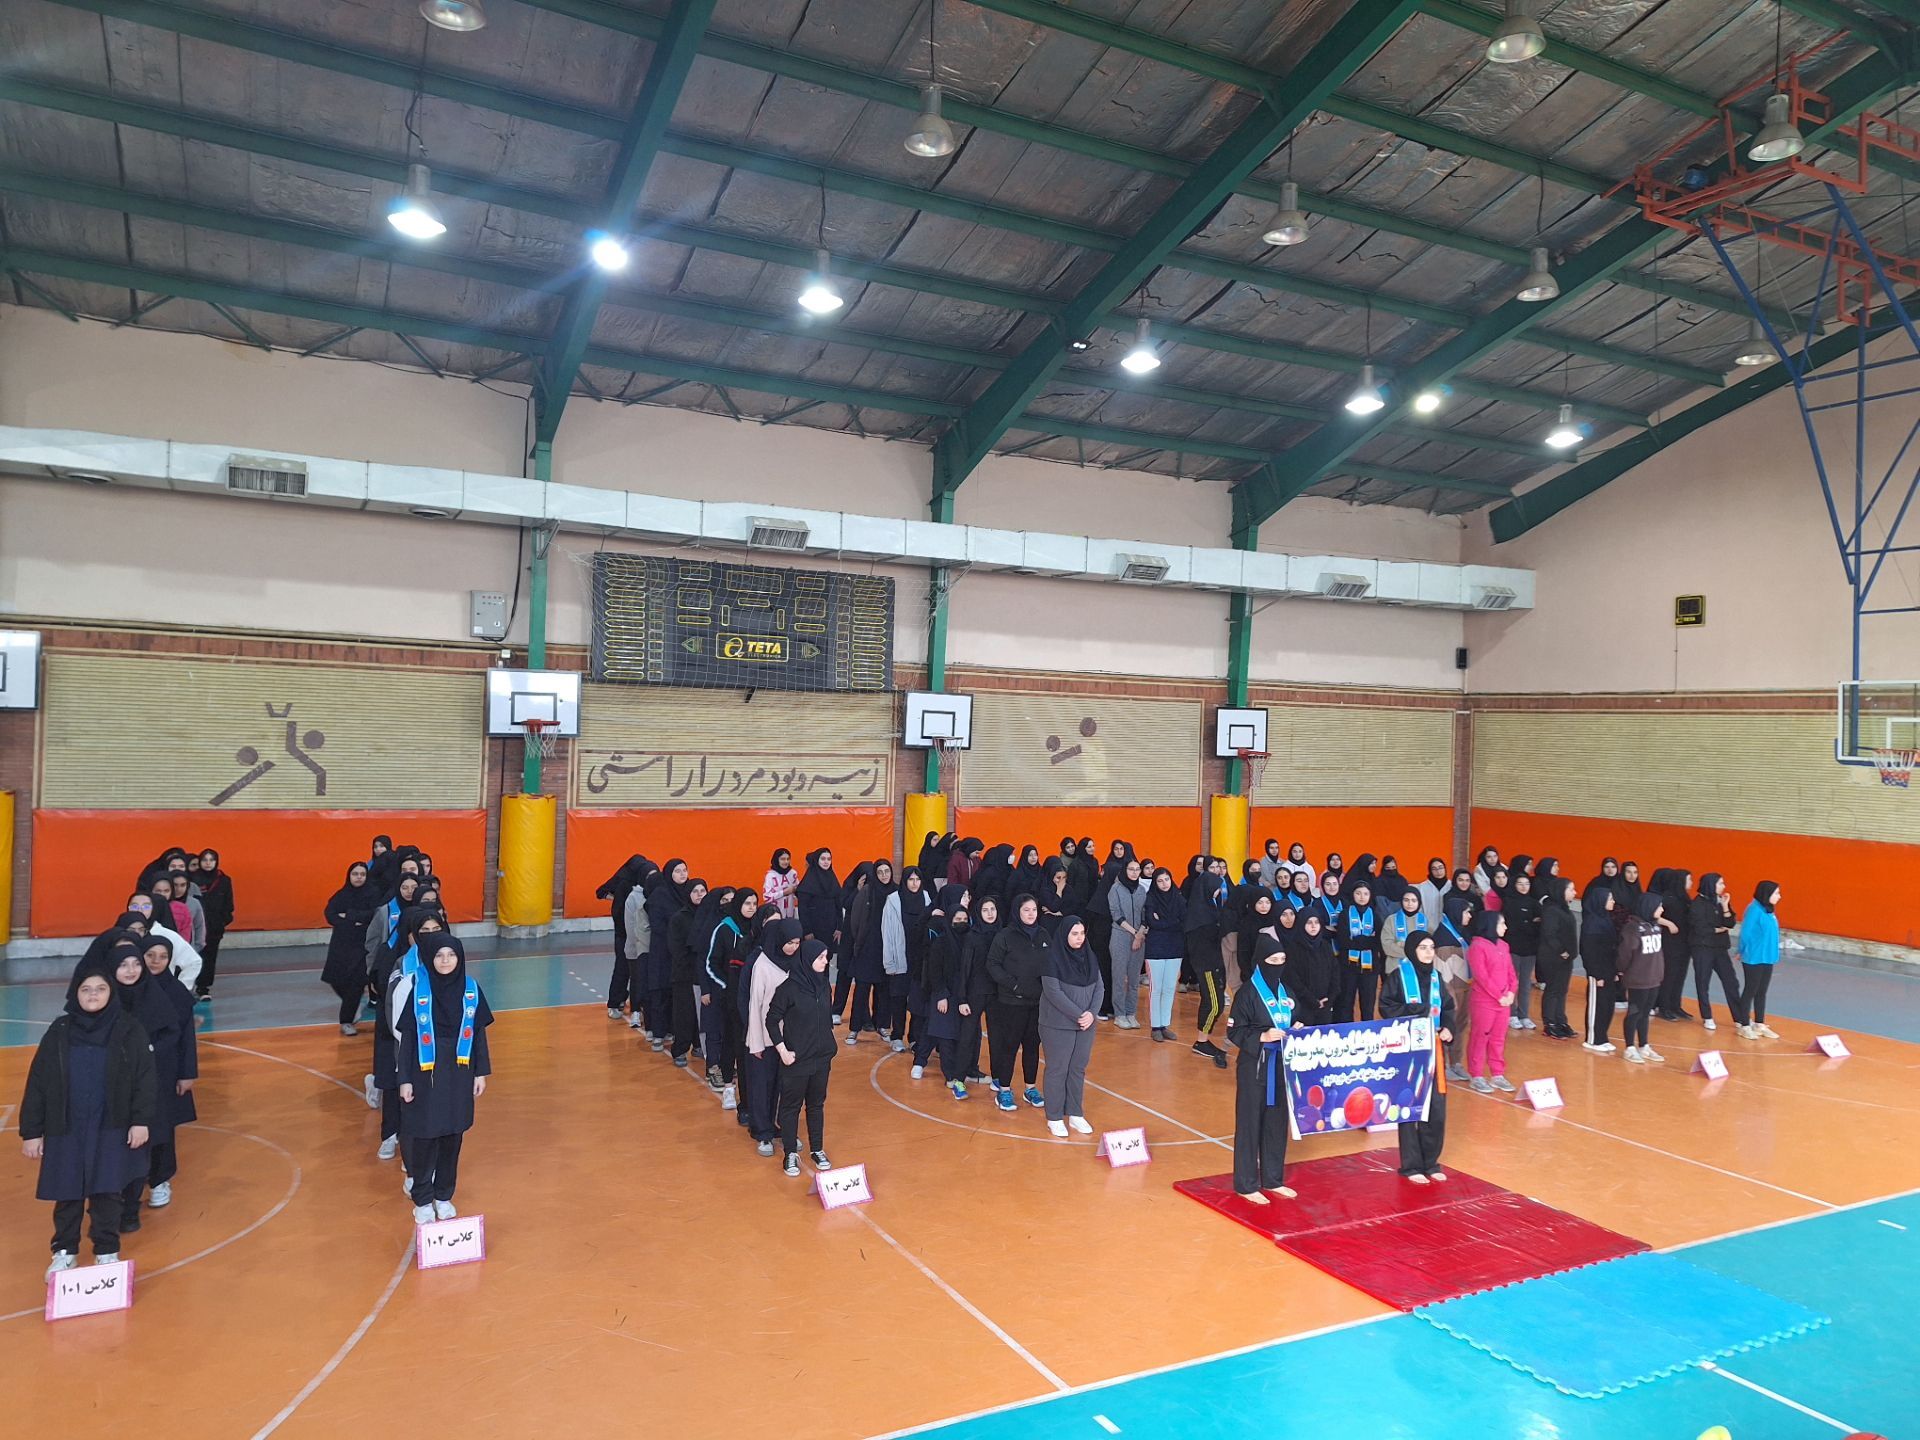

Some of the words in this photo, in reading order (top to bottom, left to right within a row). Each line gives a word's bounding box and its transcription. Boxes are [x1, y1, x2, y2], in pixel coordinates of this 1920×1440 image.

[747, 641, 781, 654] TETA
[1640, 933, 1662, 954] HO
[1126, 1139, 1140, 1151] کلاس
[825, 1181, 840, 1193] ۱۰۳
[843, 1177, 860, 1192] کلاس
[427, 1234, 445, 1248] ۱۰۲
[447, 1231, 474, 1247] کلاس
[62, 1282, 81, 1296] ۱۰۱
[84, 1277, 118, 1295] کلاس
